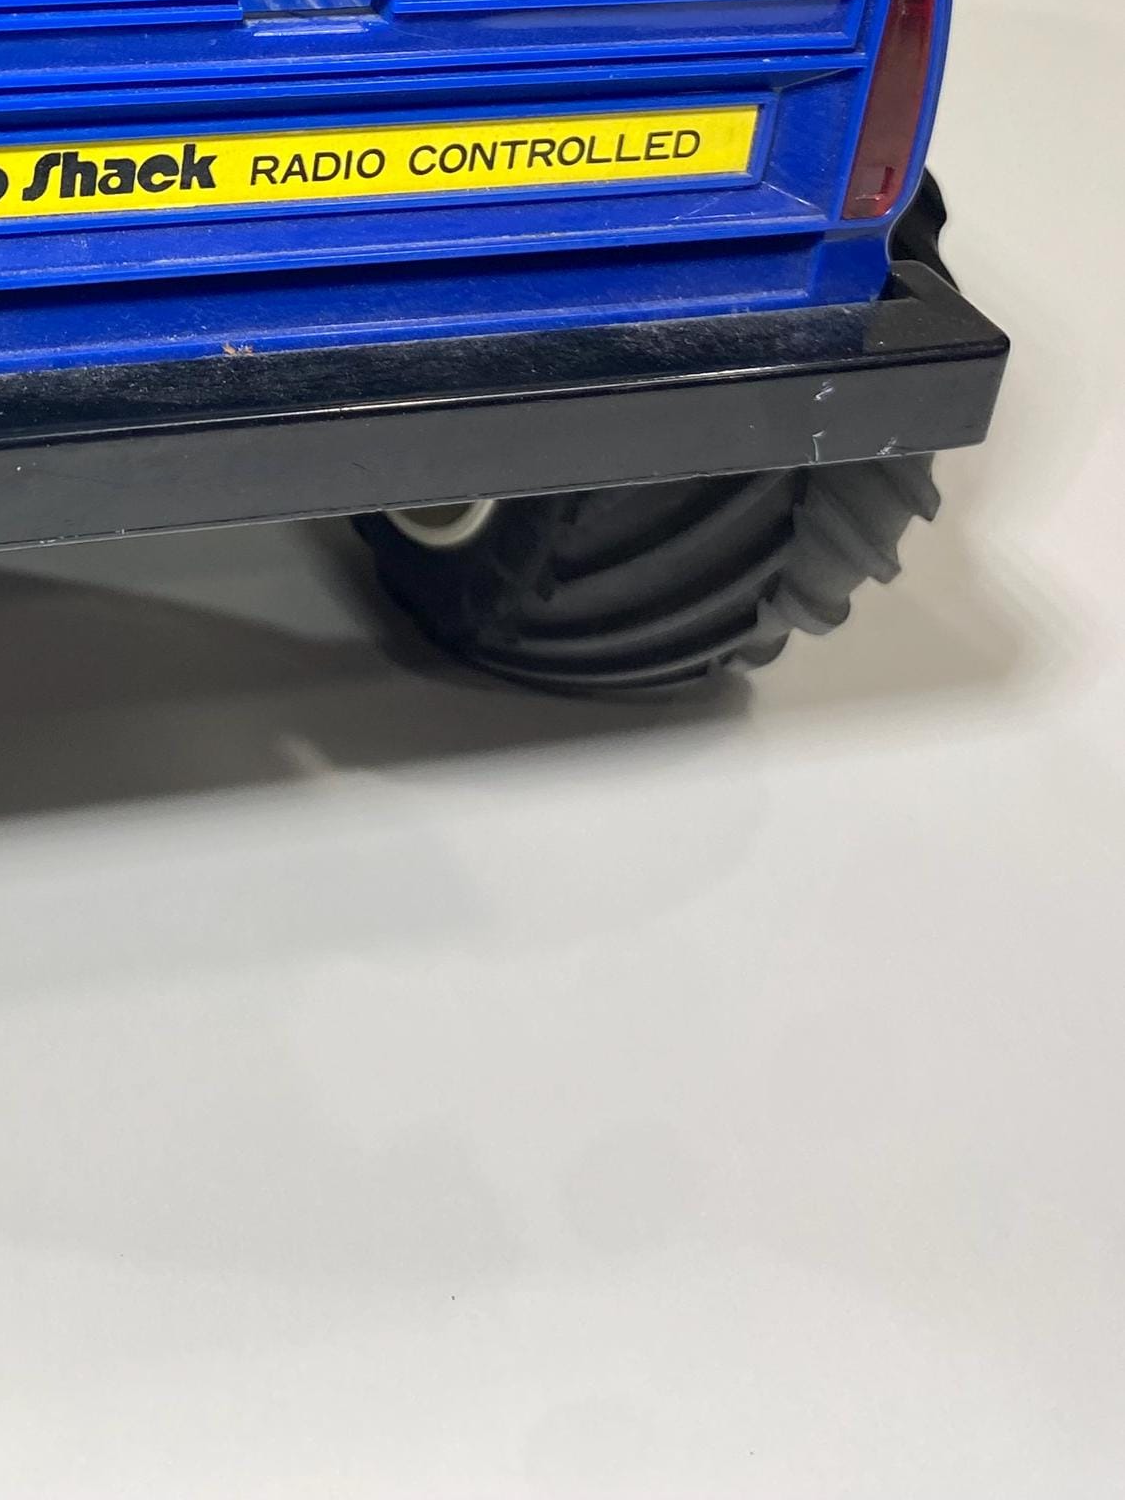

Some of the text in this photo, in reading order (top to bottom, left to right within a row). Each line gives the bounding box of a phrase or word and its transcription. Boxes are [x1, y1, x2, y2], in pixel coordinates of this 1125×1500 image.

[22, 143, 217, 202] Shack
[250, 148, 385, 186] RADIO
[409, 130, 700, 176] CONTROLLED
